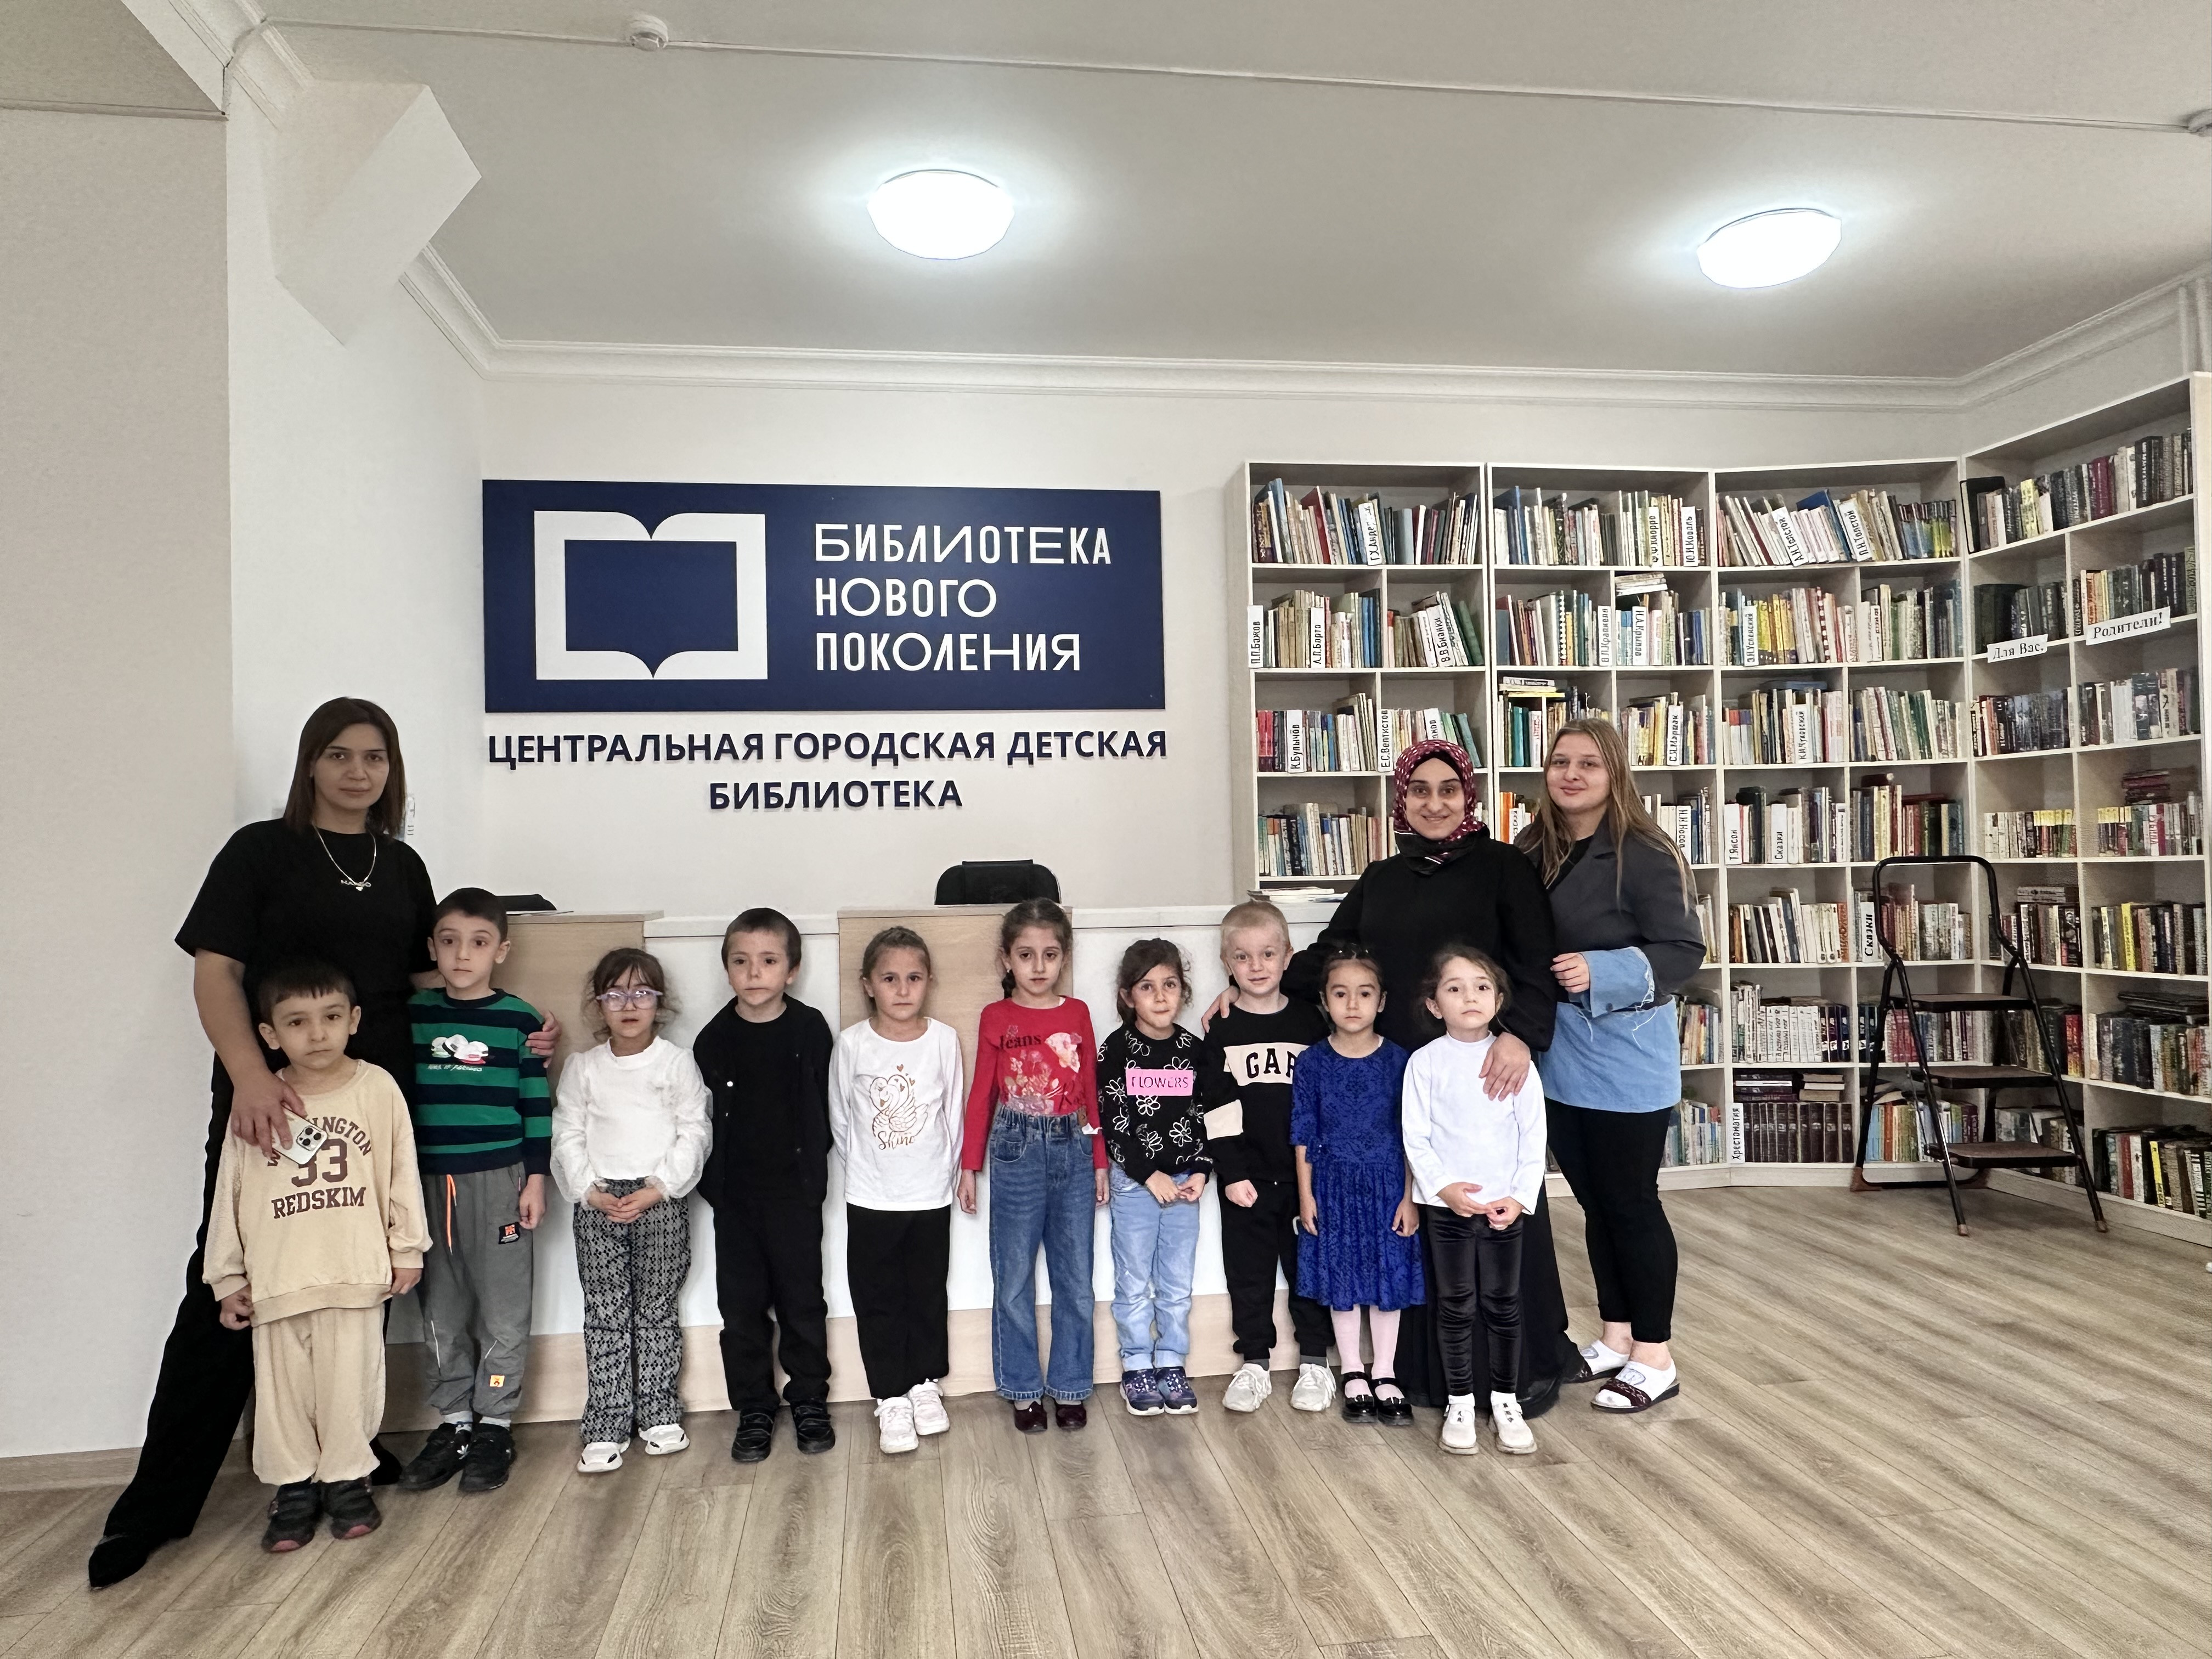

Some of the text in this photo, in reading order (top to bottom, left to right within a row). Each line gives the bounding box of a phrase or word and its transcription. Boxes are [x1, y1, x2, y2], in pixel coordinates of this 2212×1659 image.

[816, 523, 1110, 564] БИБЛИОТЕКА
[816, 578, 996, 617] НОВОГО
[2093, 612, 2163, 639] Родители!
[817, 633, 1080, 671] ПОКОЛЕНИЯ
[1993, 647, 2015, 659] Для
[489, 731, 1165, 770] ЦЕНТРАЛЬНАЯ ГОРОДСКАЯ ДЕТСКАЯ
[710, 781, 962, 809] БИБЛИОТЕКА
[1774, 832, 1783, 859] Сказки
[1864, 913, 1873, 957] Сказки
[1132, 1076, 1188, 1088] FLOWERS
[271, 1187, 366, 1218] REDSKIM
